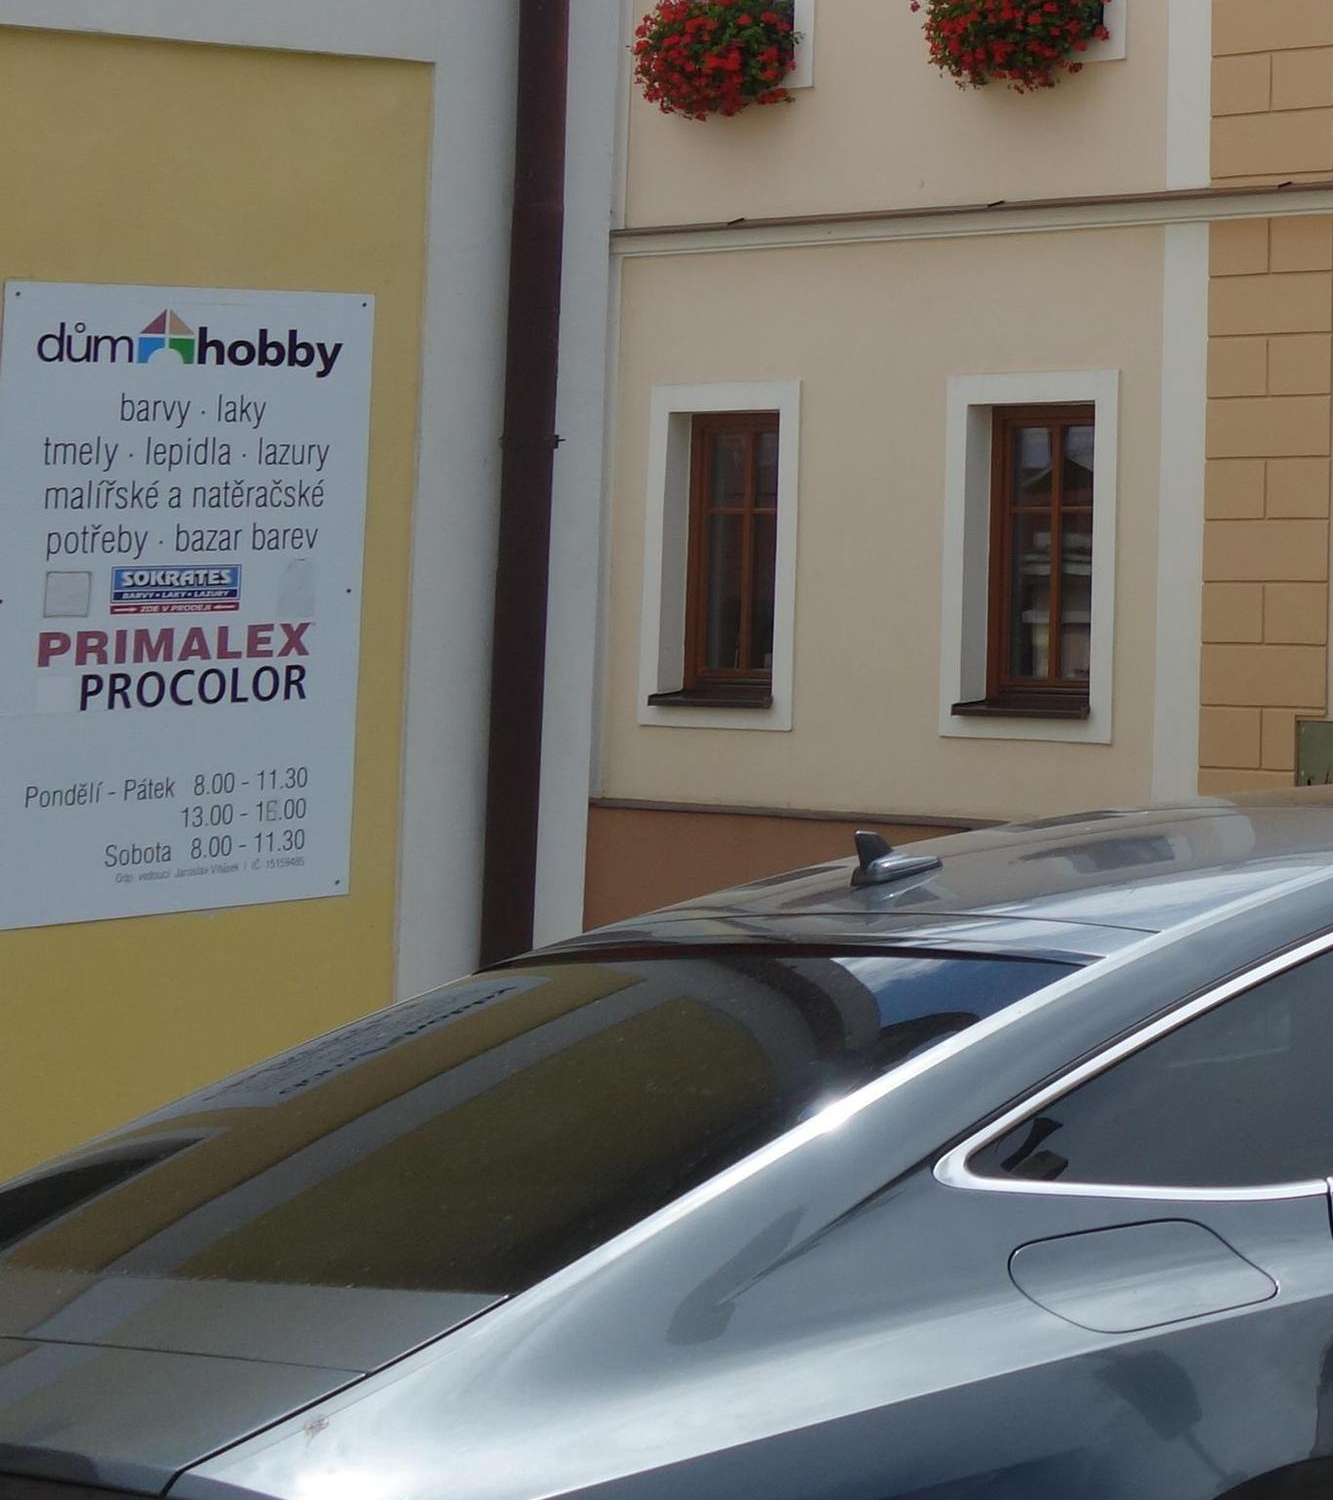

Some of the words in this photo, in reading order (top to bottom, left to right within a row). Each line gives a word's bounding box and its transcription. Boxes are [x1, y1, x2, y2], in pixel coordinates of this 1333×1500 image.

[37, 322, 134, 363] dům
[197, 326, 344, 378] hobby
[120, 392, 191, 428] barvy
[217, 394, 267, 429] laky
[43, 436, 119, 472] tmely
[146, 436, 231, 472] lepidla
[257, 437, 330, 472] lazury
[44, 479, 160, 510] malířské
[168, 487, 181, 508] a
[192, 479, 325, 509] natěračské
[46, 524, 148, 562] potřeby
[175, 523, 243, 552] bazar
[252, 522, 319, 550] barev
[121, 569, 231, 587] SOKRATES
[37, 622, 312, 668] PRIMALEX
[79, 664, 306, 712] PROCOLOR
[25, 781, 103, 809] Pondělí
[123, 776, 175, 801] Pátek
[193, 772, 235, 796] 8.00
[257, 766, 308, 791] 11.30
[180, 803, 233, 828] 13.00
[256, 797, 306, 822] 16.00
[104, 842, 171, 867] Sobota
[191, 835, 232, 860] 8.00
[254, 828, 305, 853] 11.30
